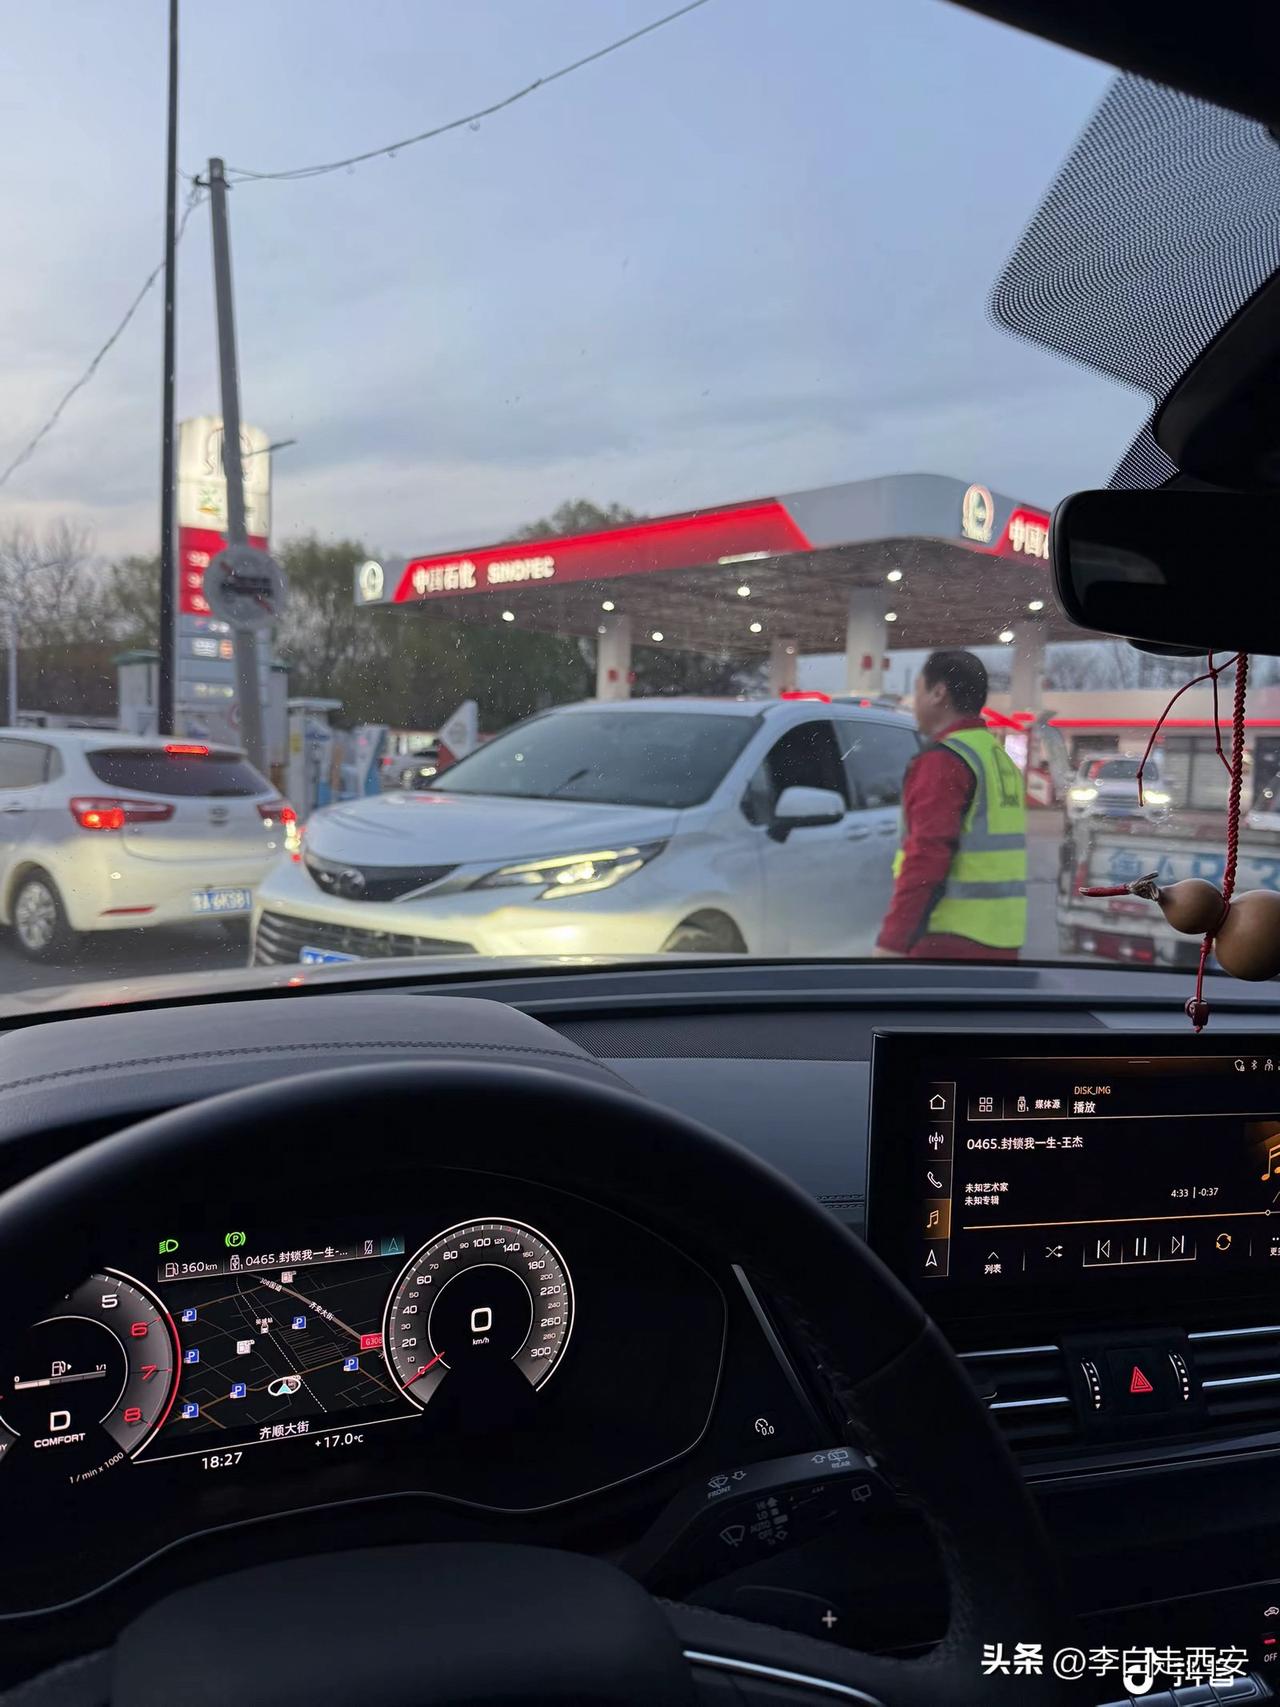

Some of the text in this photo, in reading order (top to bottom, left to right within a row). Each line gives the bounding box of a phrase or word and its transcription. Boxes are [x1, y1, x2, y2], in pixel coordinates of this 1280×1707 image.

[413, 559, 476, 594] 中国石化
[1074, 1085, 1111, 1096] DISK_IMG
[1035, 1099, 1061, 1110] 媒体源
[1073, 1101, 1097, 1114] 播放
[967, 1136, 1083, 1151] 0465.封锁我一生-王杰
[965, 1181, 1009, 1193] 未知艺术家
[1171, 1187, 1219, 1199] 4:33 -0:37
[964, 1194, 1000, 1206] 未知专辑
[473, 1238, 491, 1247] 100
[503, 1243, 520, 1252] 140
[443, 1251, 458, 1260] 80
[528, 1261, 544, 1270] 180
[984, 1263, 1002, 1275] 列表
[417, 1276, 431, 1284] 60
[540, 1285, 561, 1295] 220
[102, 1294, 118, 1308] 5
[403, 1305, 418, 1314] 40
[471, 1307, 492, 1332] 0
[541, 1317, 561, 1327] 260
[131, 1321, 148, 1336] 6
[402, 1338, 416, 1347] 20
[473, 1337, 489, 1345] km/h
[531, 1347, 551, 1357] 300
[141, 1365, 157, 1380] 7
[50, 1410, 71, 1431] D
[124, 1408, 141, 1422] 8
[259, 1421, 309, 1440] 齐顺大街
[34, 1433, 86, 1448] COMFORT
[104, 1452, 125, 1469] 1000
[202, 1452, 243, 1470] 18:27
[832, 1460, 850, 1469] REAR
[707, 1485, 732, 1499] FRONT
[1264, 1652, 1278, 1662] OFF
